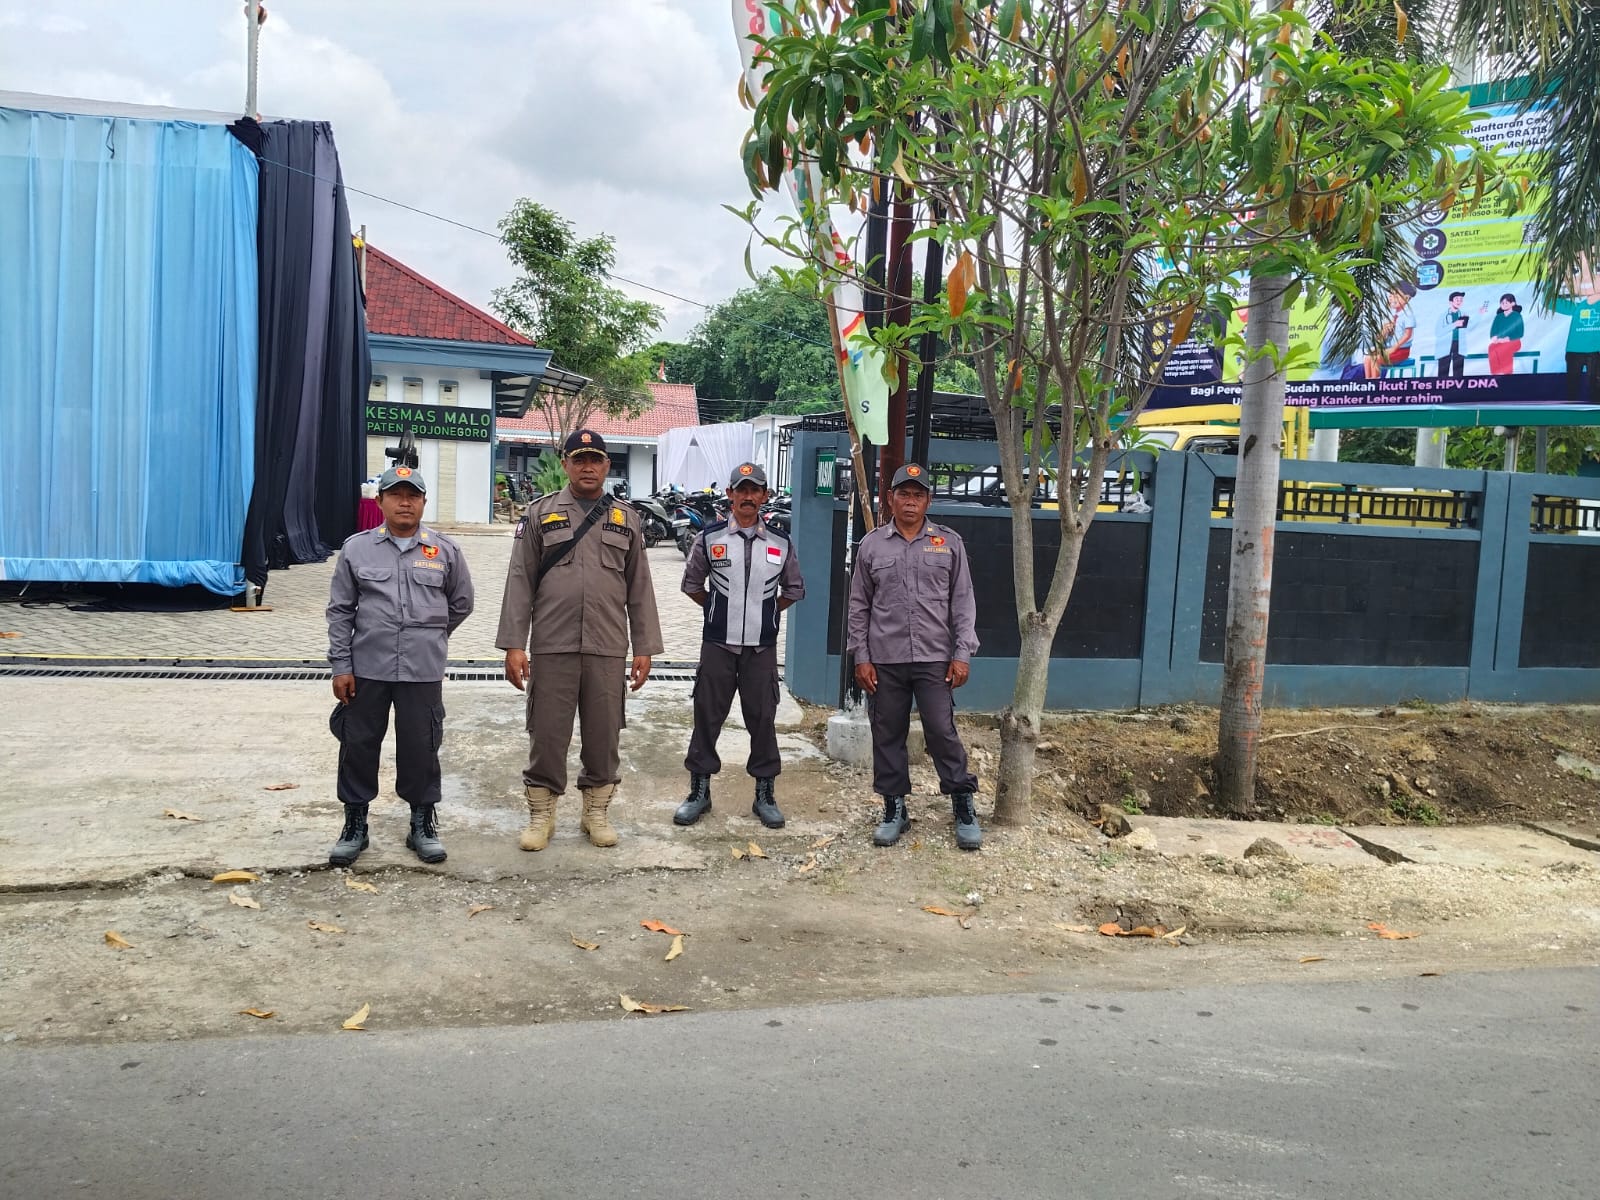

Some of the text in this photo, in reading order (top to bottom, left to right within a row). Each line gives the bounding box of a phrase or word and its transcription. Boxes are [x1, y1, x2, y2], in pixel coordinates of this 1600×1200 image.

[1460, 119, 1523, 134] endaftaran
[1450, 229, 1480, 238] SATELIT
[1190, 387, 1214, 397] Bagi
[1284, 384, 1320, 394] Sudah
[1322, 382, 1376, 392] menikah
[1378, 381, 1408, 391] ikuti
[1410, 380, 1432, 390] Tes
[1435, 379, 1465, 389] HPV
[1467, 378, 1499, 389] DNA
[1284, 392, 1443, 407] rining Kanker Leher rahim
[366, 406, 491, 427] KESMAS MALO
[367, 422, 488, 439] PATEN BOJONEGORO
